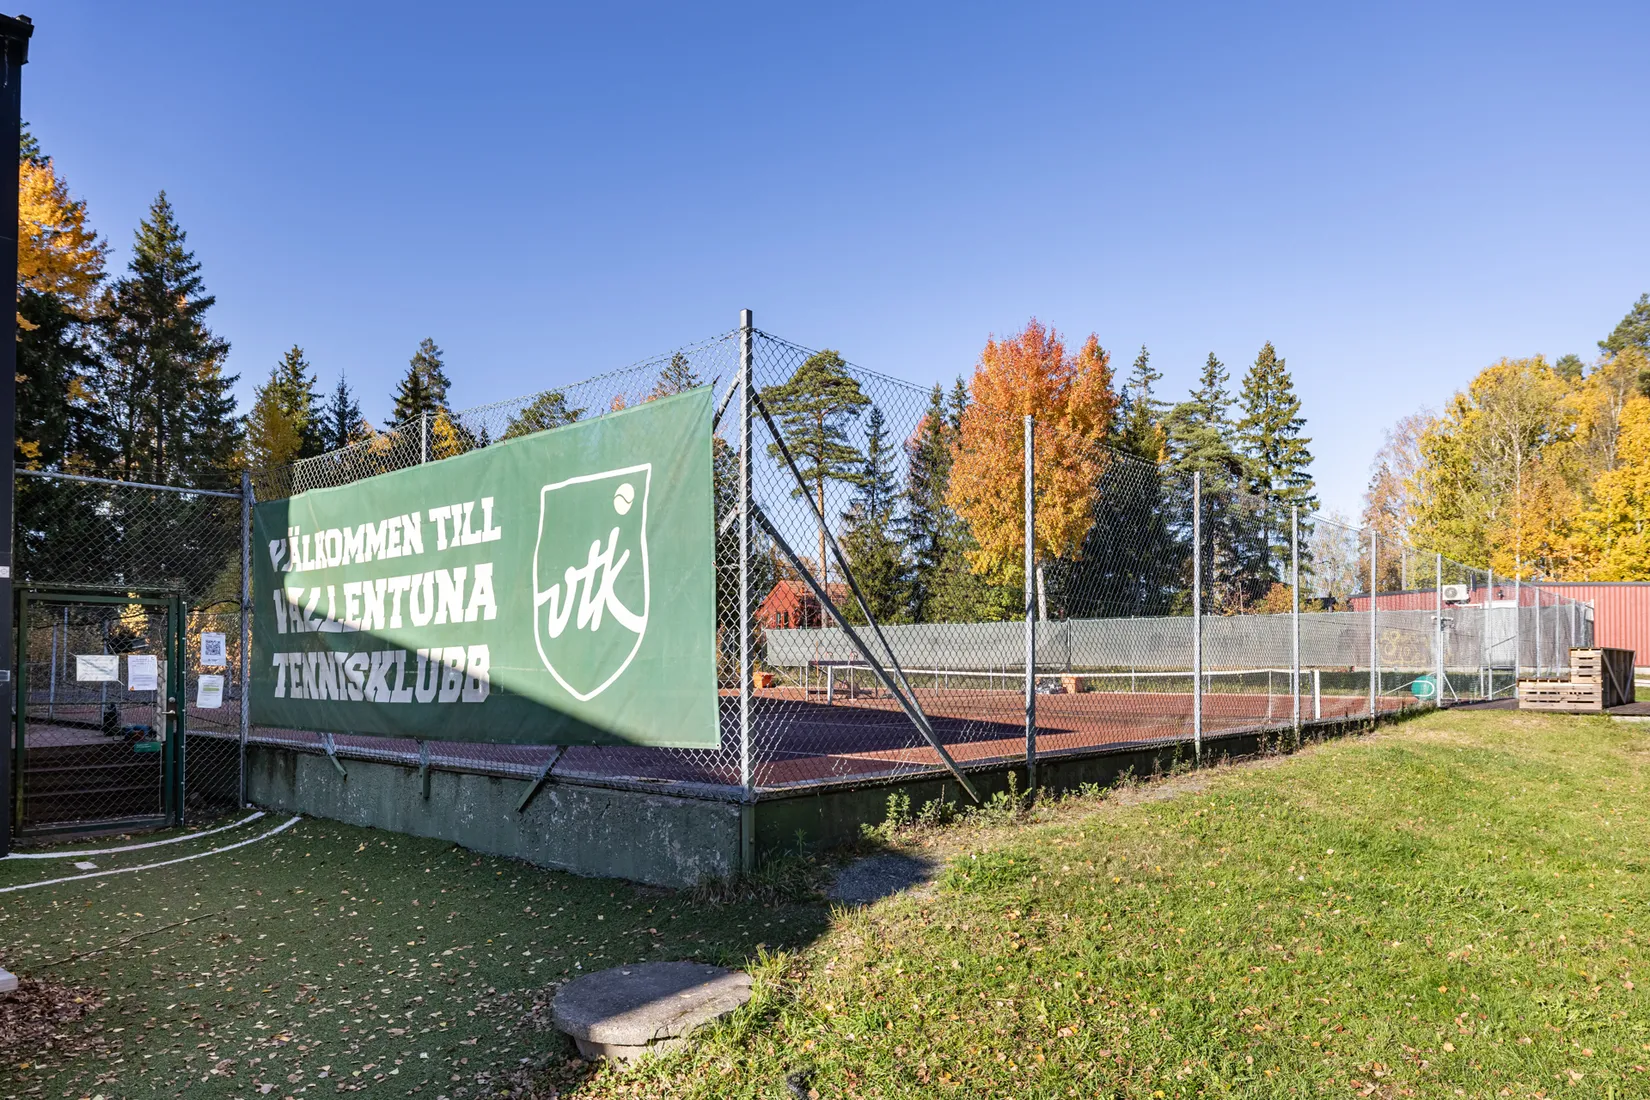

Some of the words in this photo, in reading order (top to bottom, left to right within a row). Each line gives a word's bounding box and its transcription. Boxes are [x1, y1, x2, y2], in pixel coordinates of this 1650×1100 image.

[268, 511, 424, 572] VÄLKOMMEN
[428, 497, 501, 551] TILL
[273, 562, 498, 634] VALLENTUNA
[272, 644, 490, 703] TENNISKLUBB
